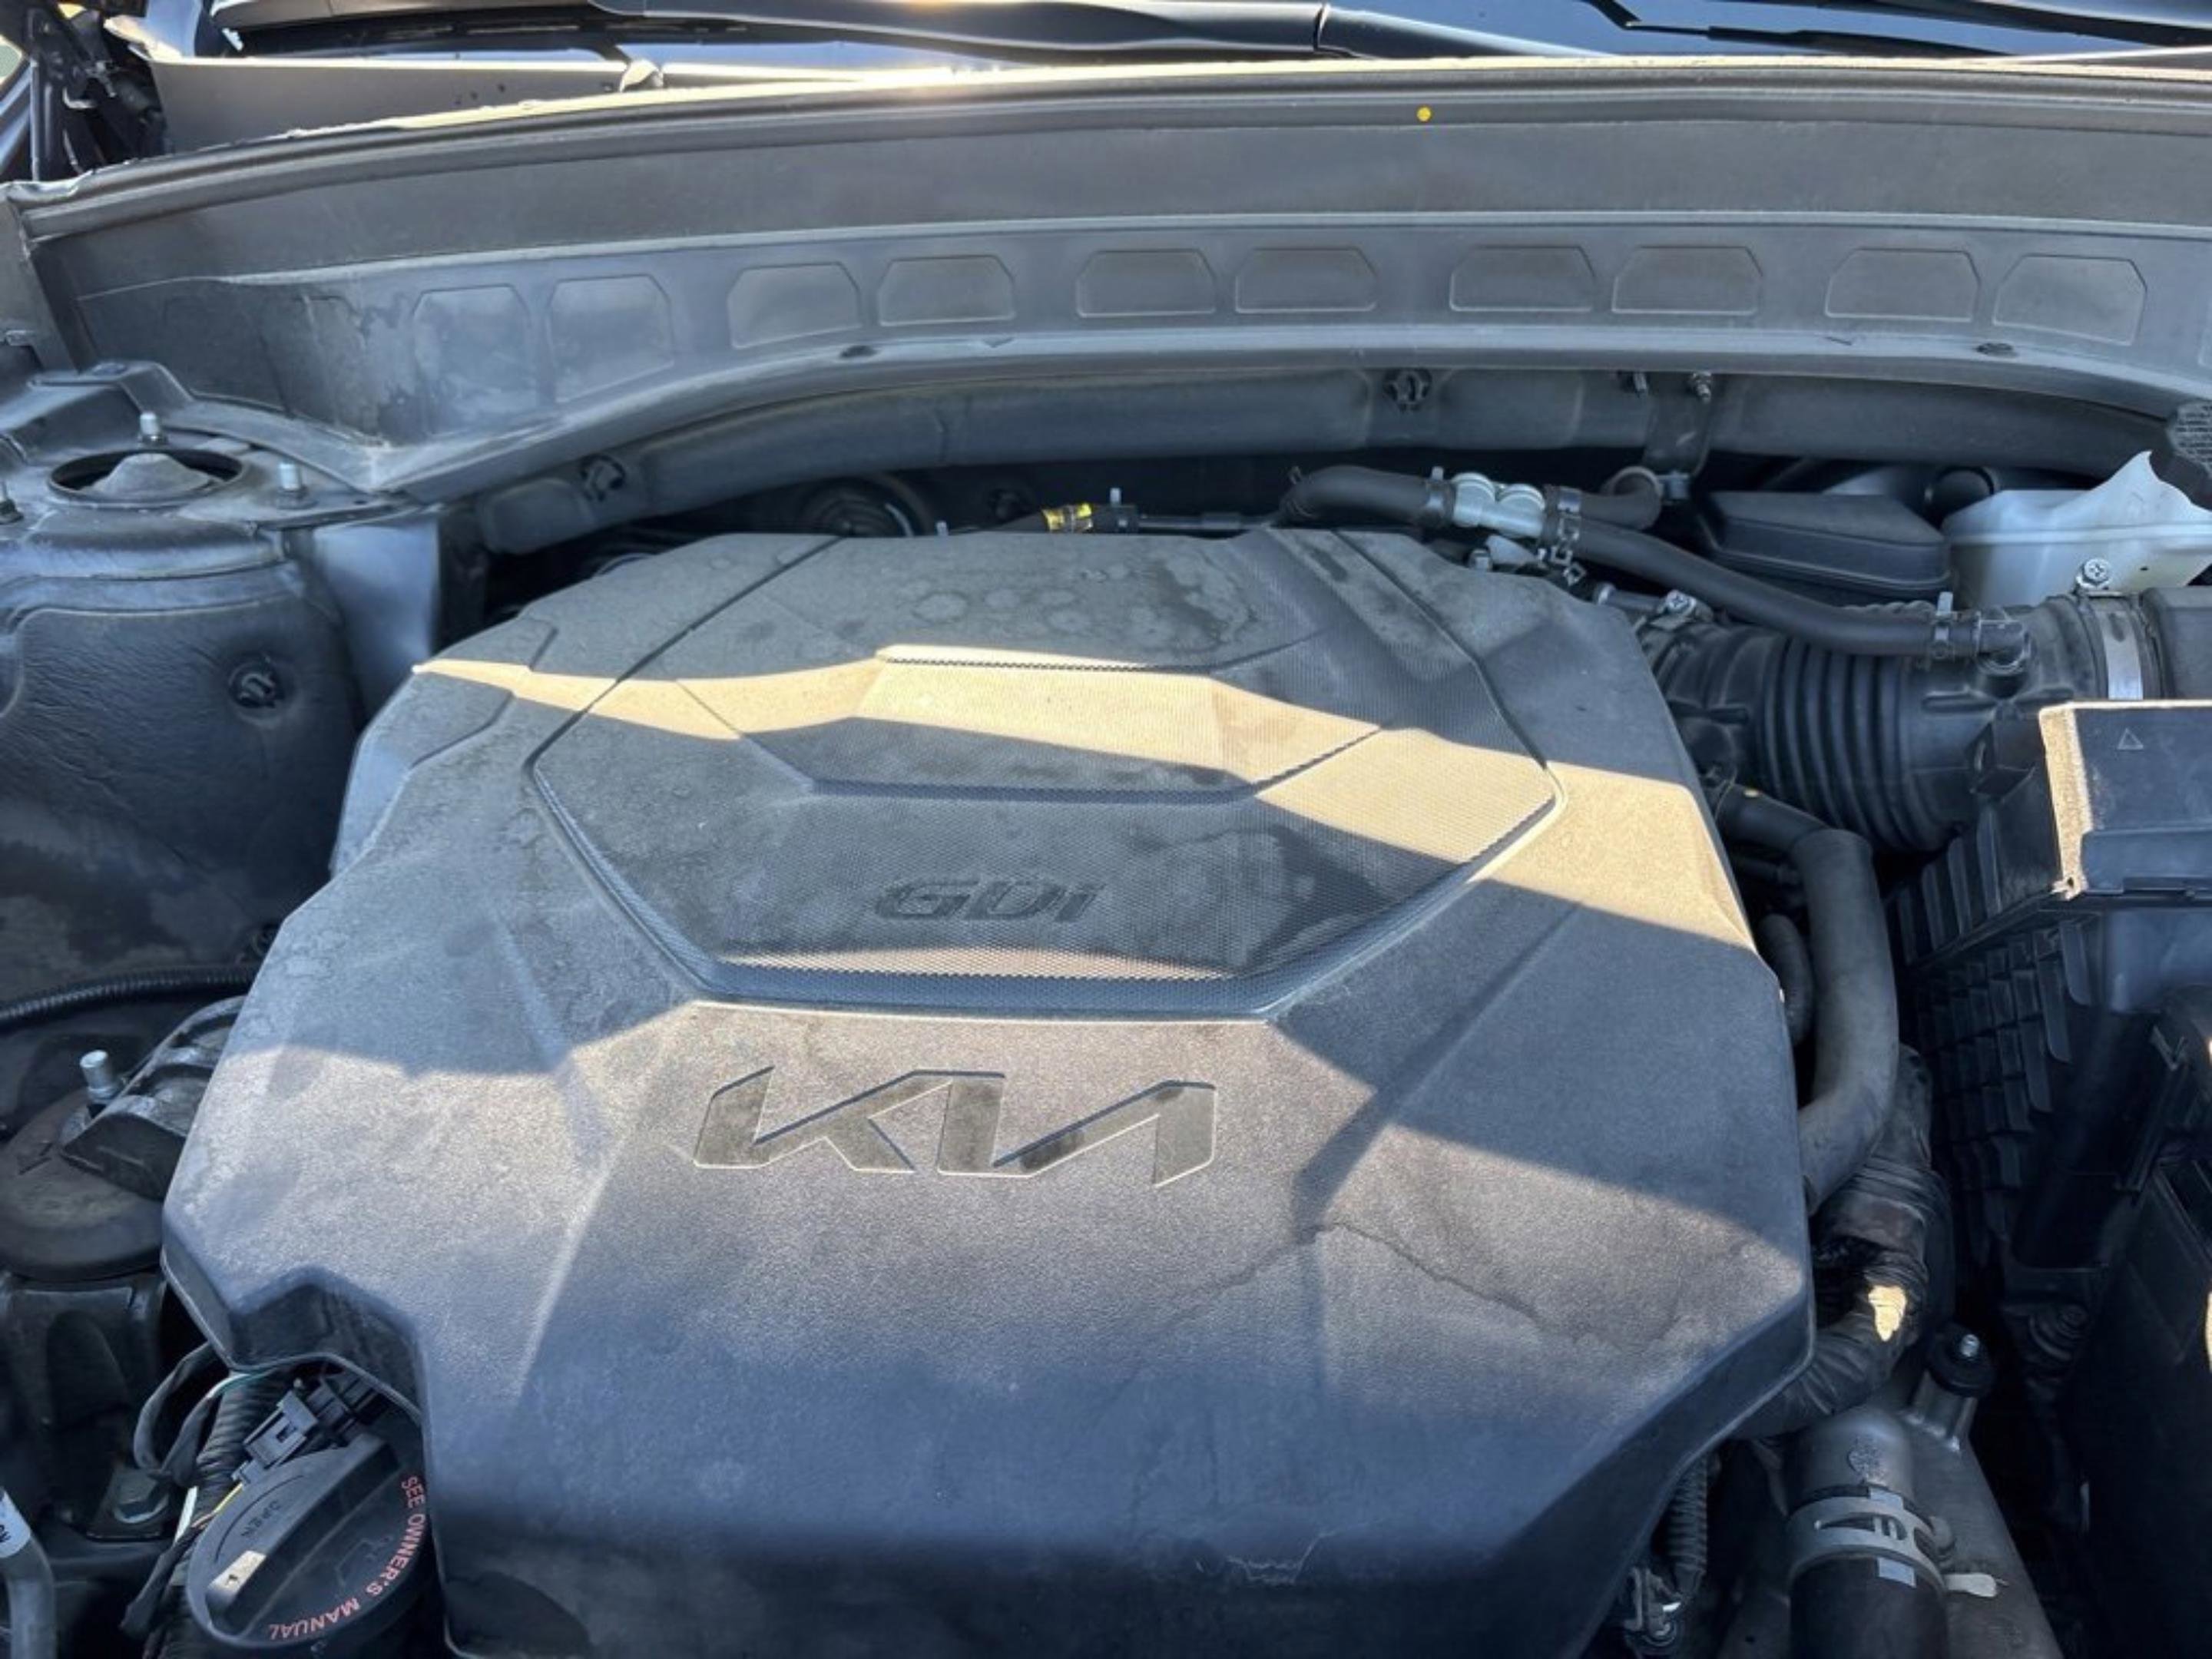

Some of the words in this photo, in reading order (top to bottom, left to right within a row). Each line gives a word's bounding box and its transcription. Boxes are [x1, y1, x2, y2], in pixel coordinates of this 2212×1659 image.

[693, 1065, 1217, 1187] KIA
[401, 1476, 426, 1509] SEE
[366, 1513, 426, 1596] OWNER'S
[270, 1597, 361, 1641] MANUAL
